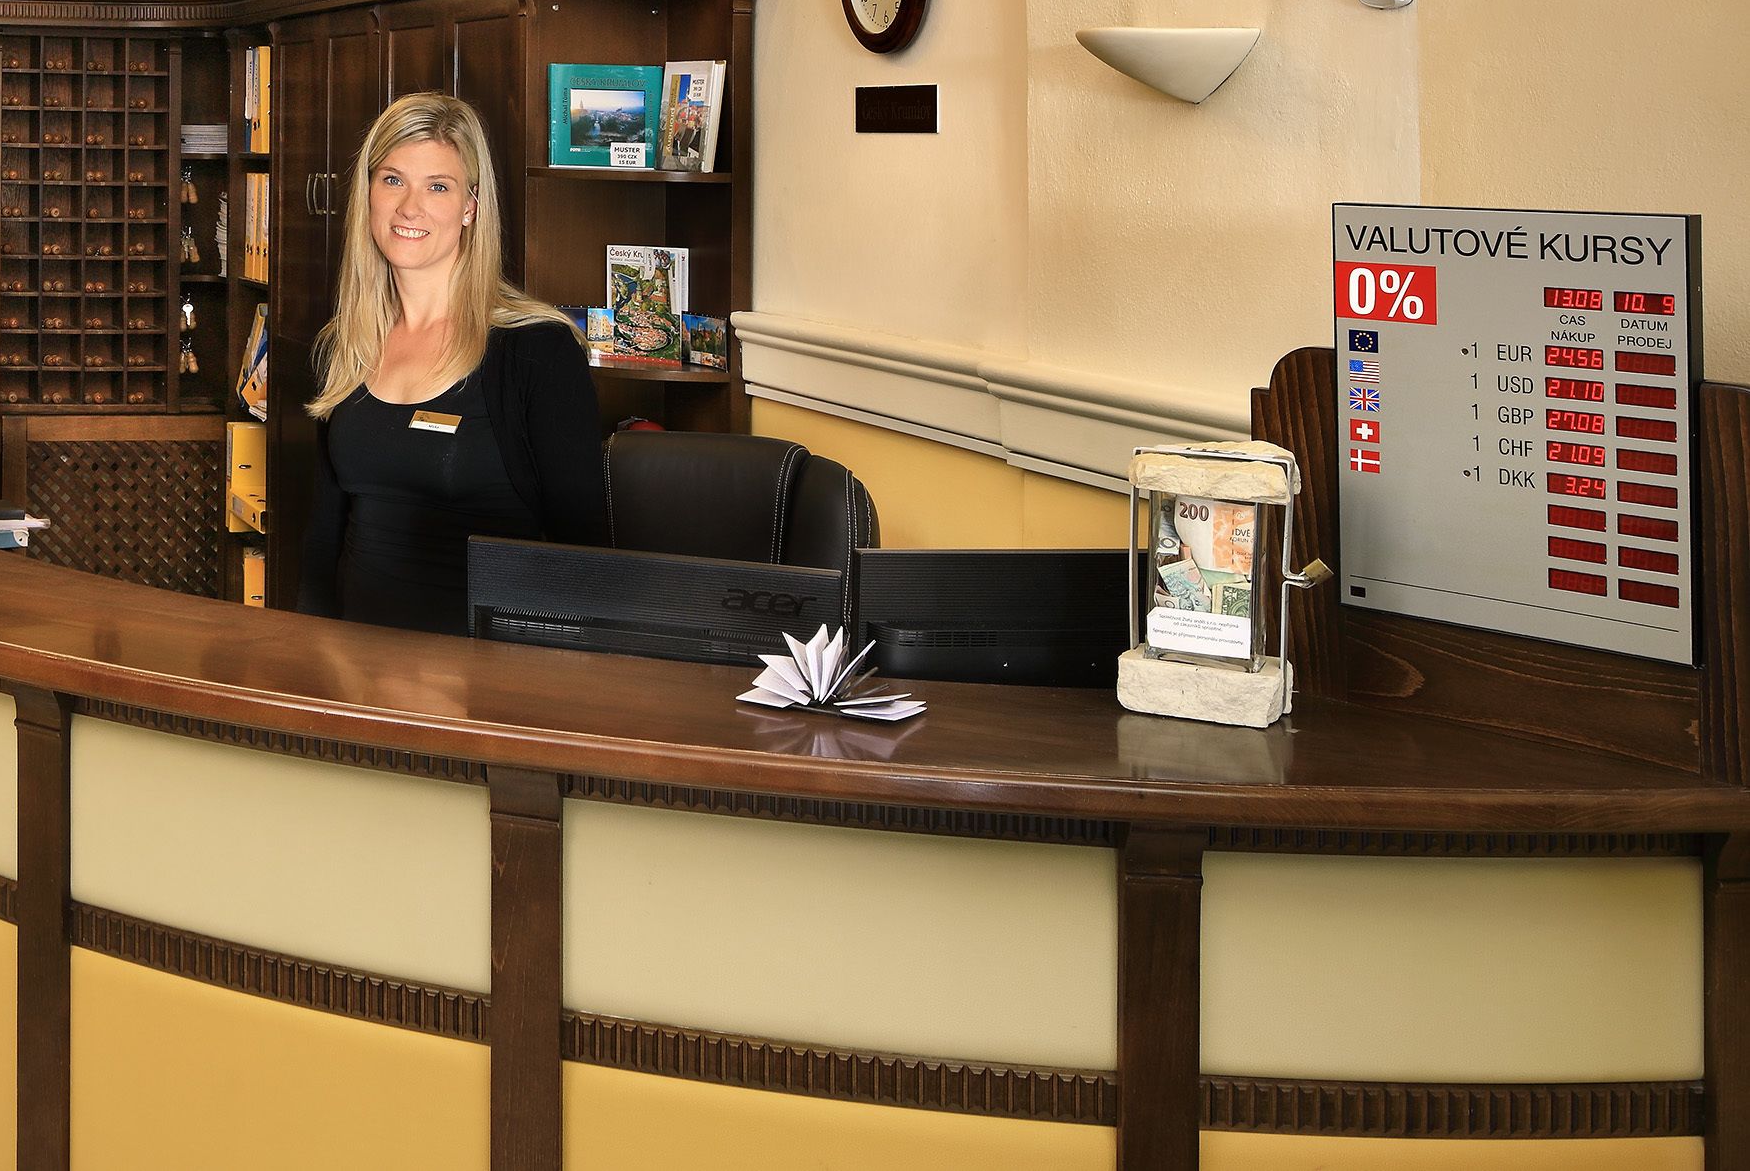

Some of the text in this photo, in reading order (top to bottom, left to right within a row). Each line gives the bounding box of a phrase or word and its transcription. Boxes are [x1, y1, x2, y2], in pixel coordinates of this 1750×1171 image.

[872, 3, 877, 18] 7
[883, 10, 889, 24] 6
[610, 247, 631, 258] Český
[1346, 225, 1673, 266] VALUTOVÉ KURSY
[1348, 267, 1424, 320] 0%
[1553, 289, 1603, 309] 13.08
[1559, 314, 1668, 332] CAS DATUM
[1551, 330, 1672, 349] NÁKUP PRODEJ
[1471, 341, 1602, 368] 1 EUR 24.56
[1470, 373, 1604, 401] 1 USD 21.10
[1471, 403, 1604, 433] 1 GBP 27.08
[1472, 435, 1605, 465] 1 CHF 21.09
[1473, 465, 1606, 498] 1 DKK 3.24
[1179, 501, 1210, 522] 200
[721, 587, 818, 616] acer
